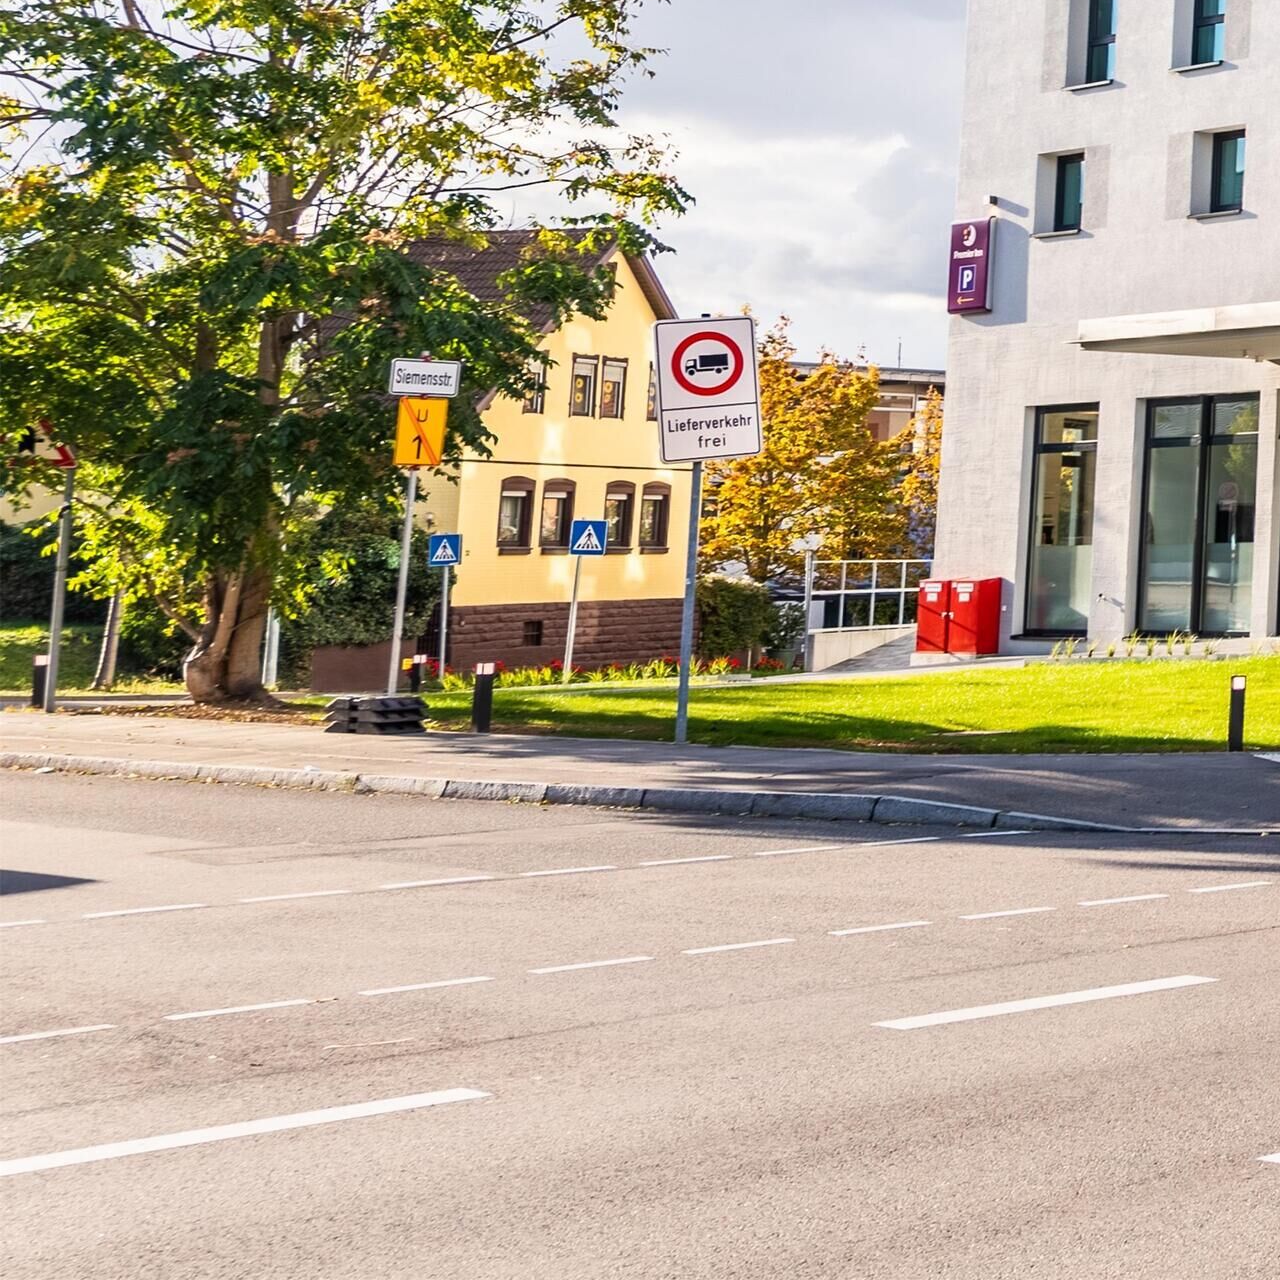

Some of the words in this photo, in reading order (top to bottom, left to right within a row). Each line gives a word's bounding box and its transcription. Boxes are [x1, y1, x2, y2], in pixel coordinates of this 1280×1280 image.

[953, 249, 974, 259] Premier
[962, 269, 973, 289] P
[395, 367, 453, 387] Siemensstr.
[667, 414, 752, 433] Lieferverkehr
[697, 433, 727, 448] frei
